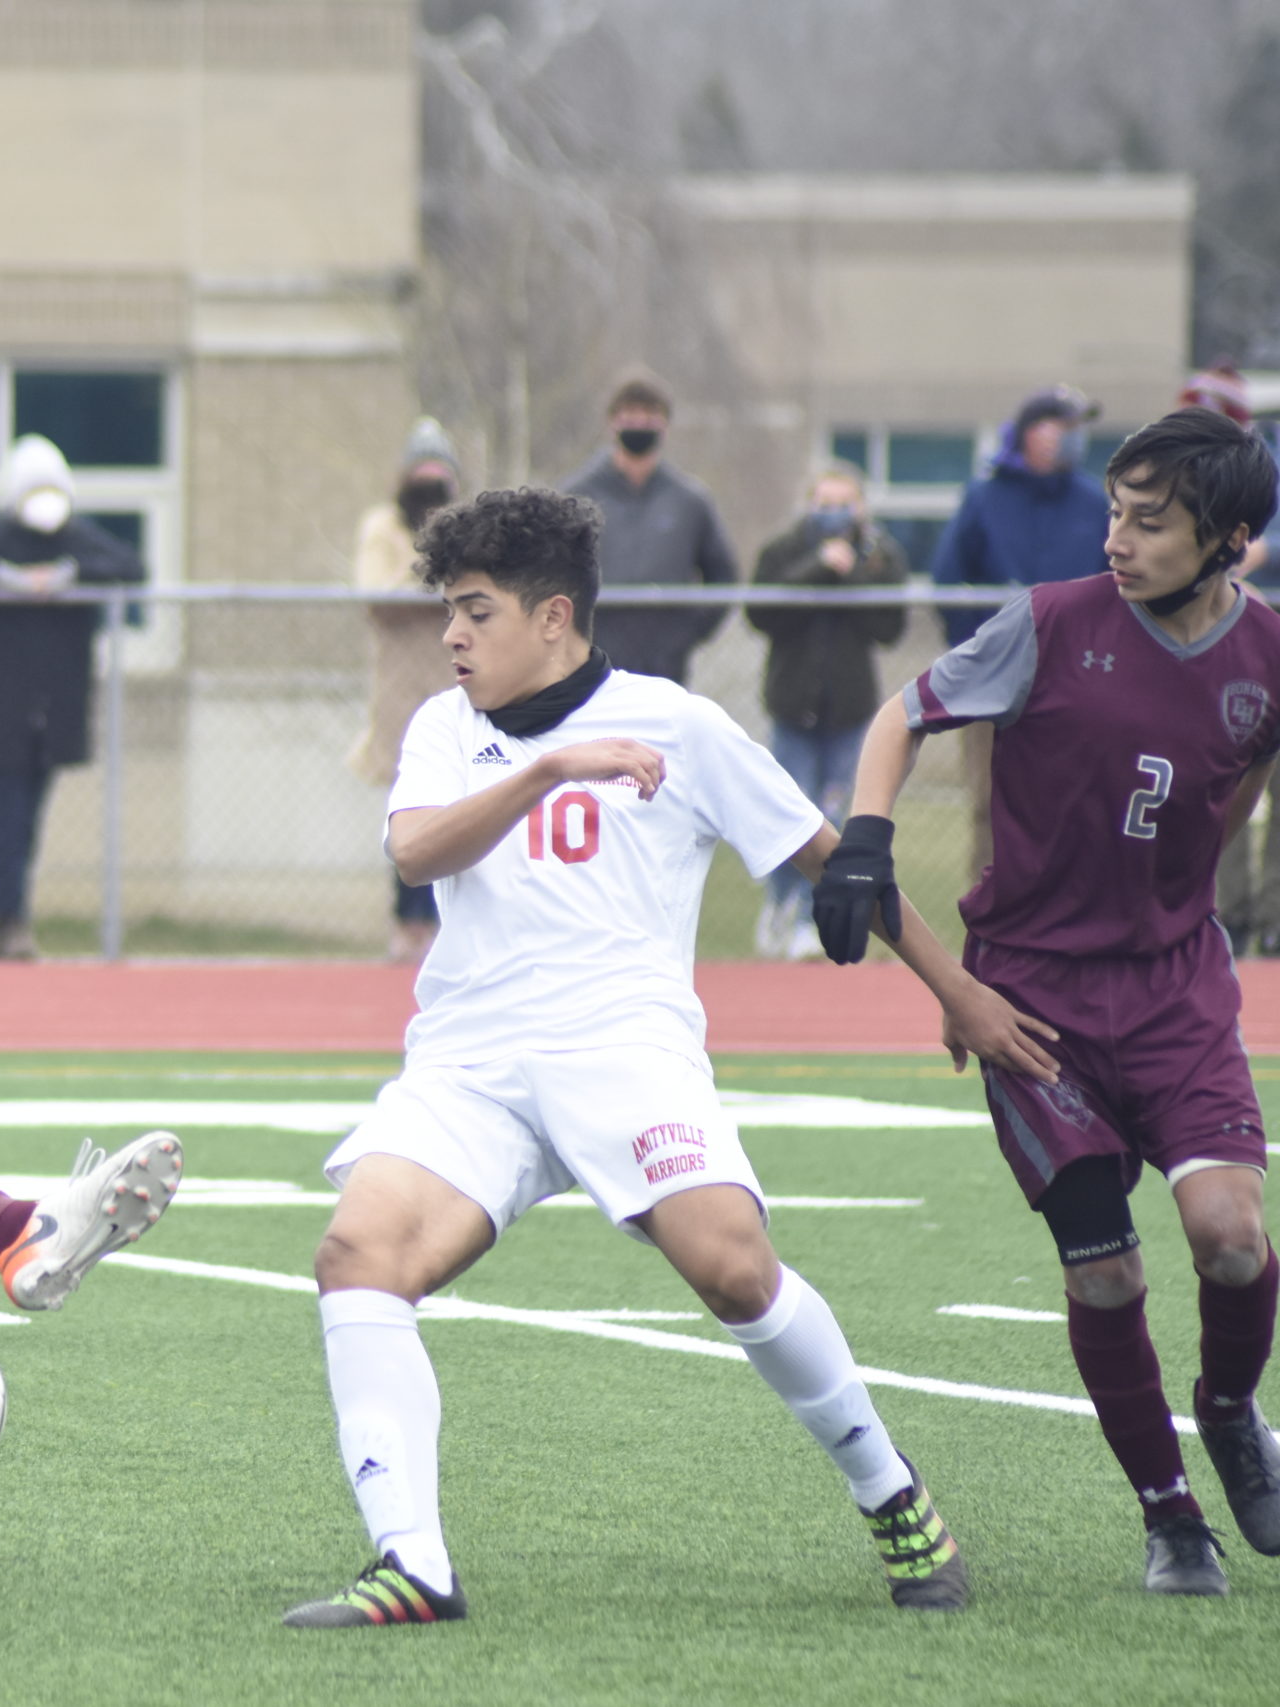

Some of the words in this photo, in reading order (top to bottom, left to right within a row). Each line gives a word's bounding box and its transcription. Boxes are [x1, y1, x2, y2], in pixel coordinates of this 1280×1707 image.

[471, 755, 513, 766] adidas
[1123, 753, 1174, 840] 2
[527, 790, 600, 865] 10
[631, 1122, 707, 1165] AMITYVILLE
[644, 1152, 705, 1187] WARRIORS
[1065, 1239, 1122, 1260] ZENSAH
